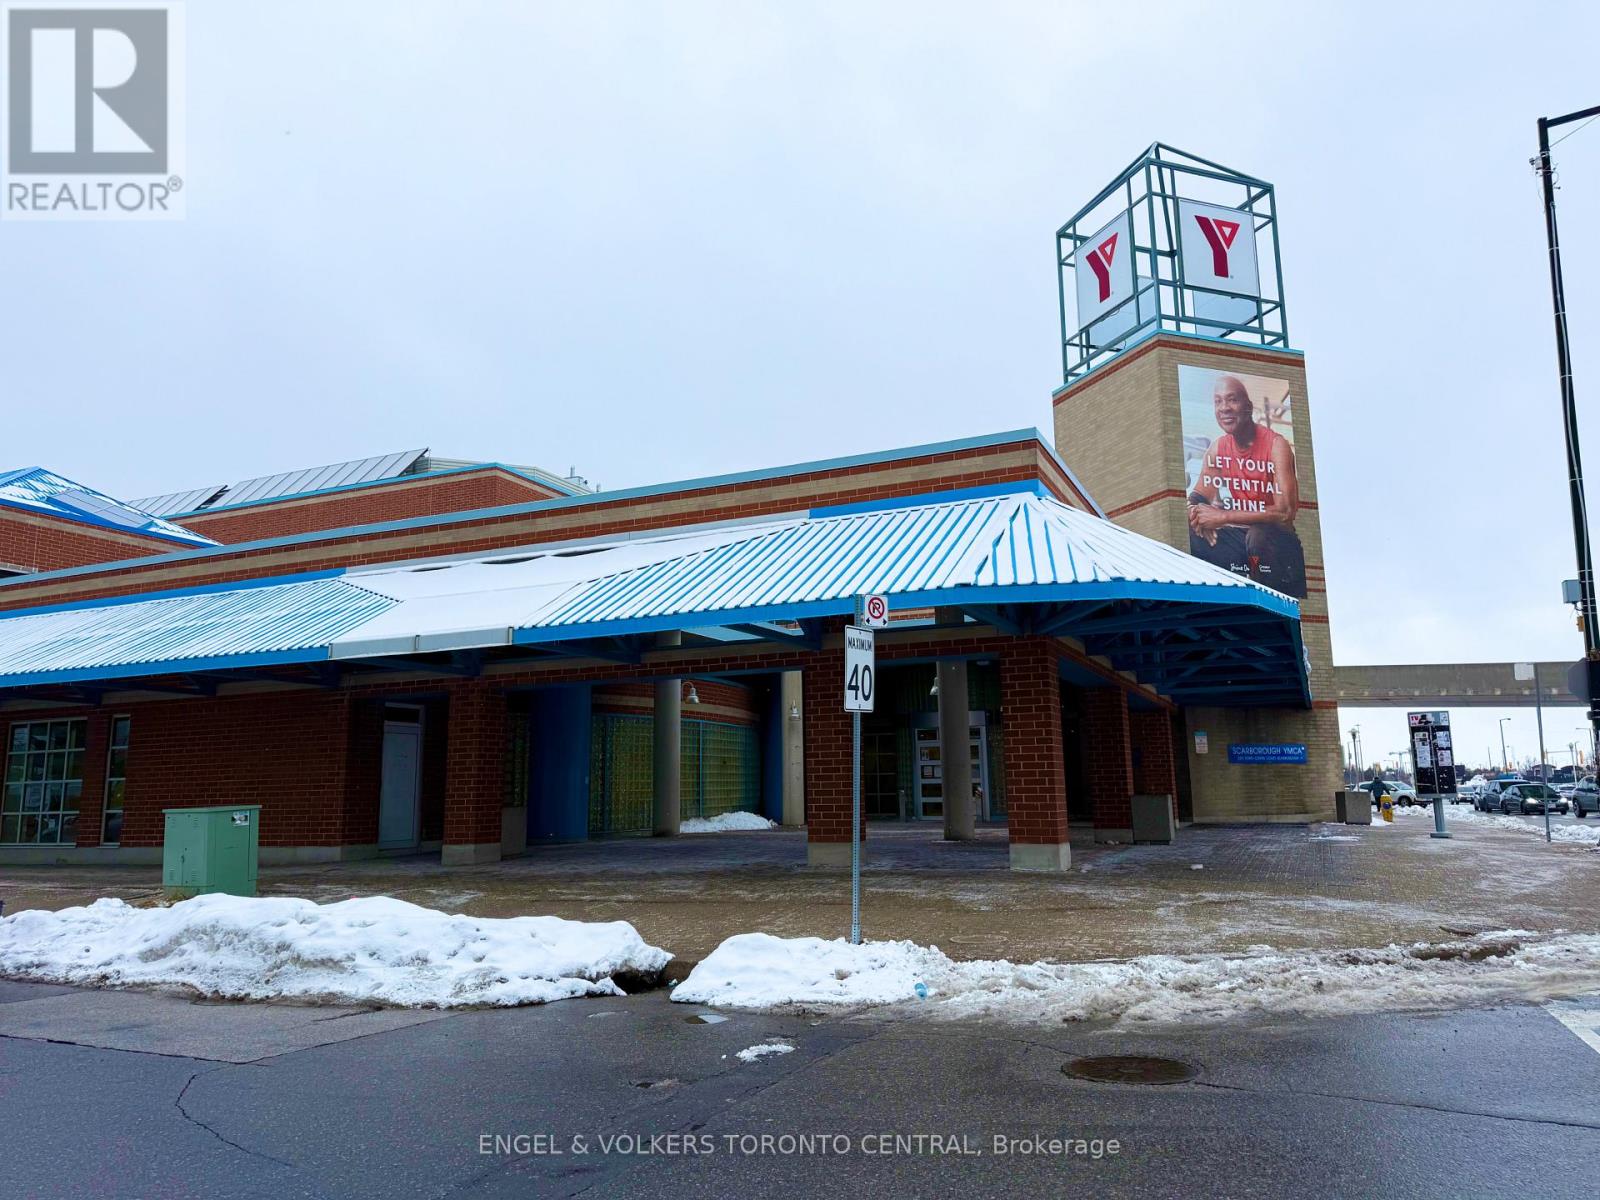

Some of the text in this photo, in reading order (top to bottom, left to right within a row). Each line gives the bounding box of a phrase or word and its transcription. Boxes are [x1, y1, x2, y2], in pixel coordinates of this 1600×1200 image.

[1207, 455, 1275, 474] LET YOUR
[1203, 475, 1283, 495] POTENTIAL
[1223, 498, 1267, 513] SHINE
[847, 636, 873, 652] MAXIMUM
[847, 663, 873, 702] 40
[1232, 746, 1303, 755] SCARBOROUGH YMCA
